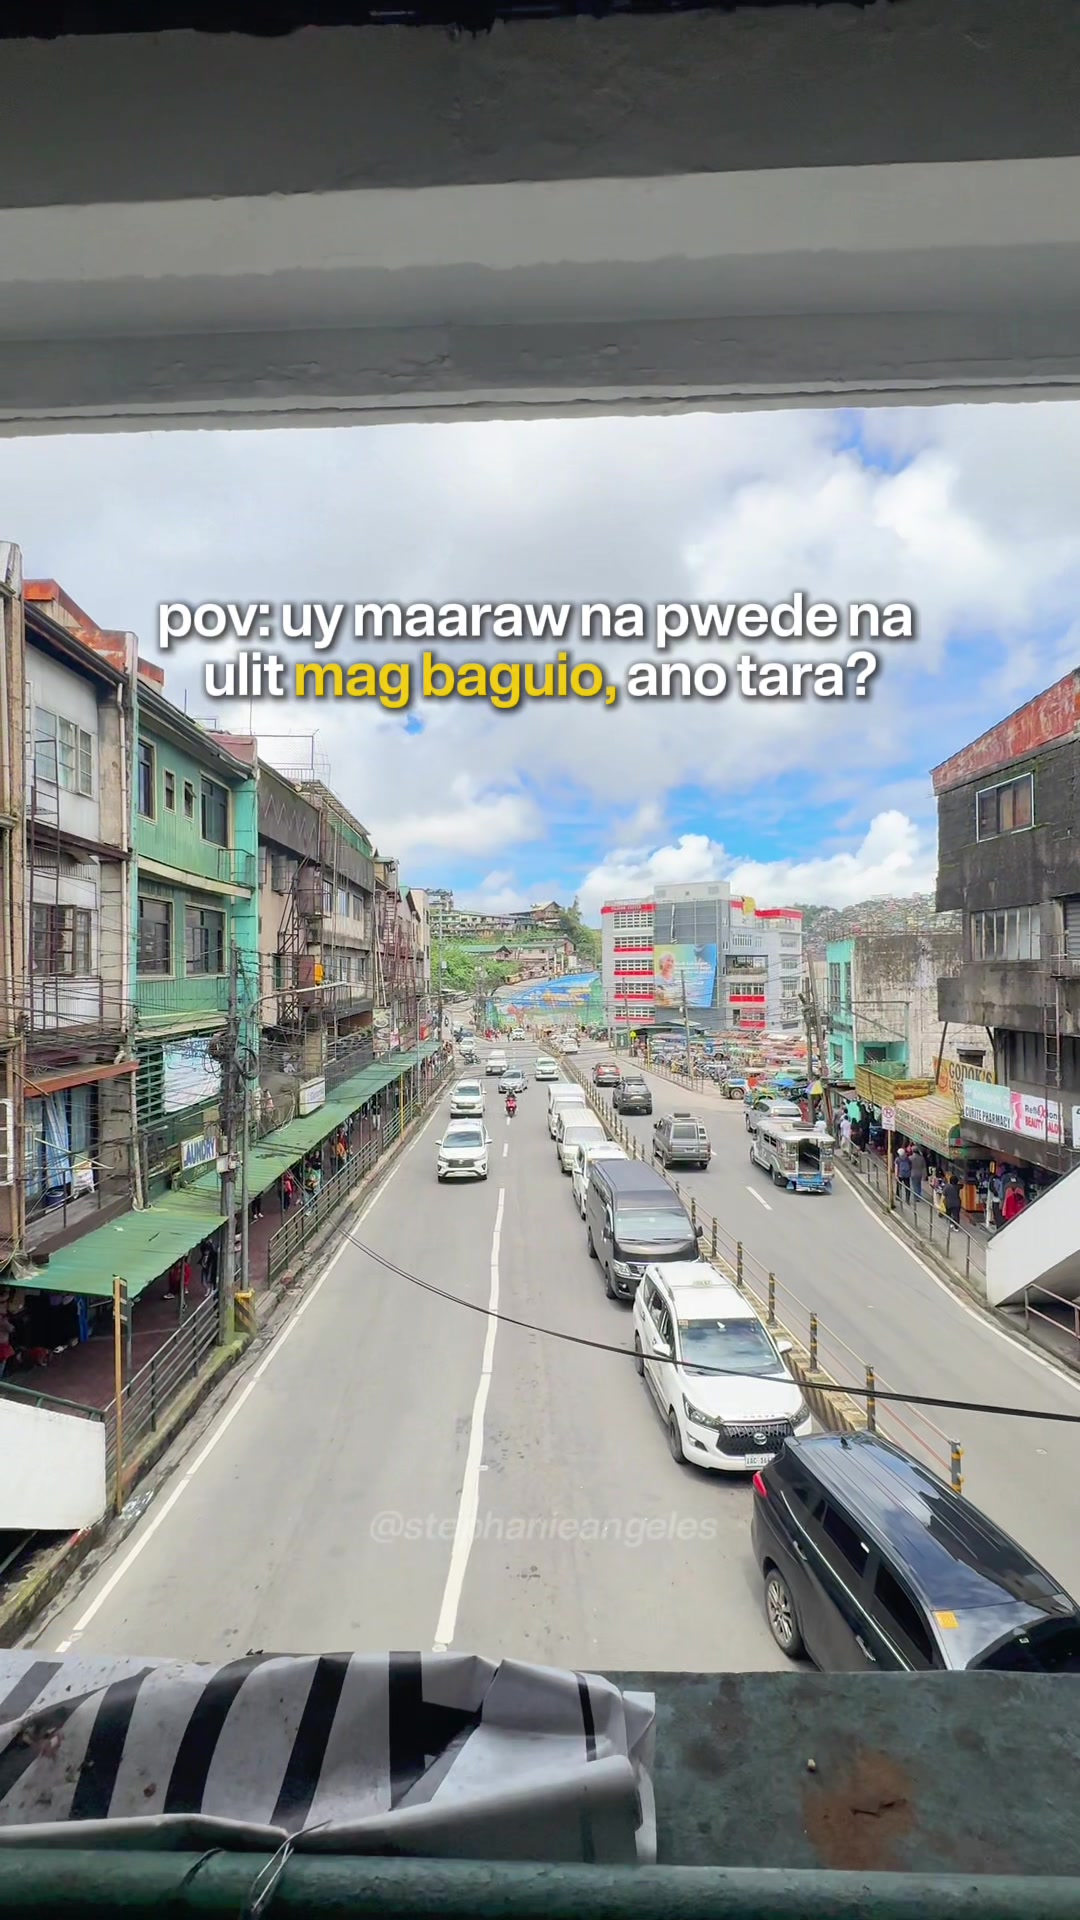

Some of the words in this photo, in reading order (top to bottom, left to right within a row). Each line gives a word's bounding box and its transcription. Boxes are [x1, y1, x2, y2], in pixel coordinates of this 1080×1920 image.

[965, 1105, 982, 1120] CURITE
[982, 1110, 1011, 1129] PHARMACY
[1025, 1116, 1044, 1130] BEAUTY
